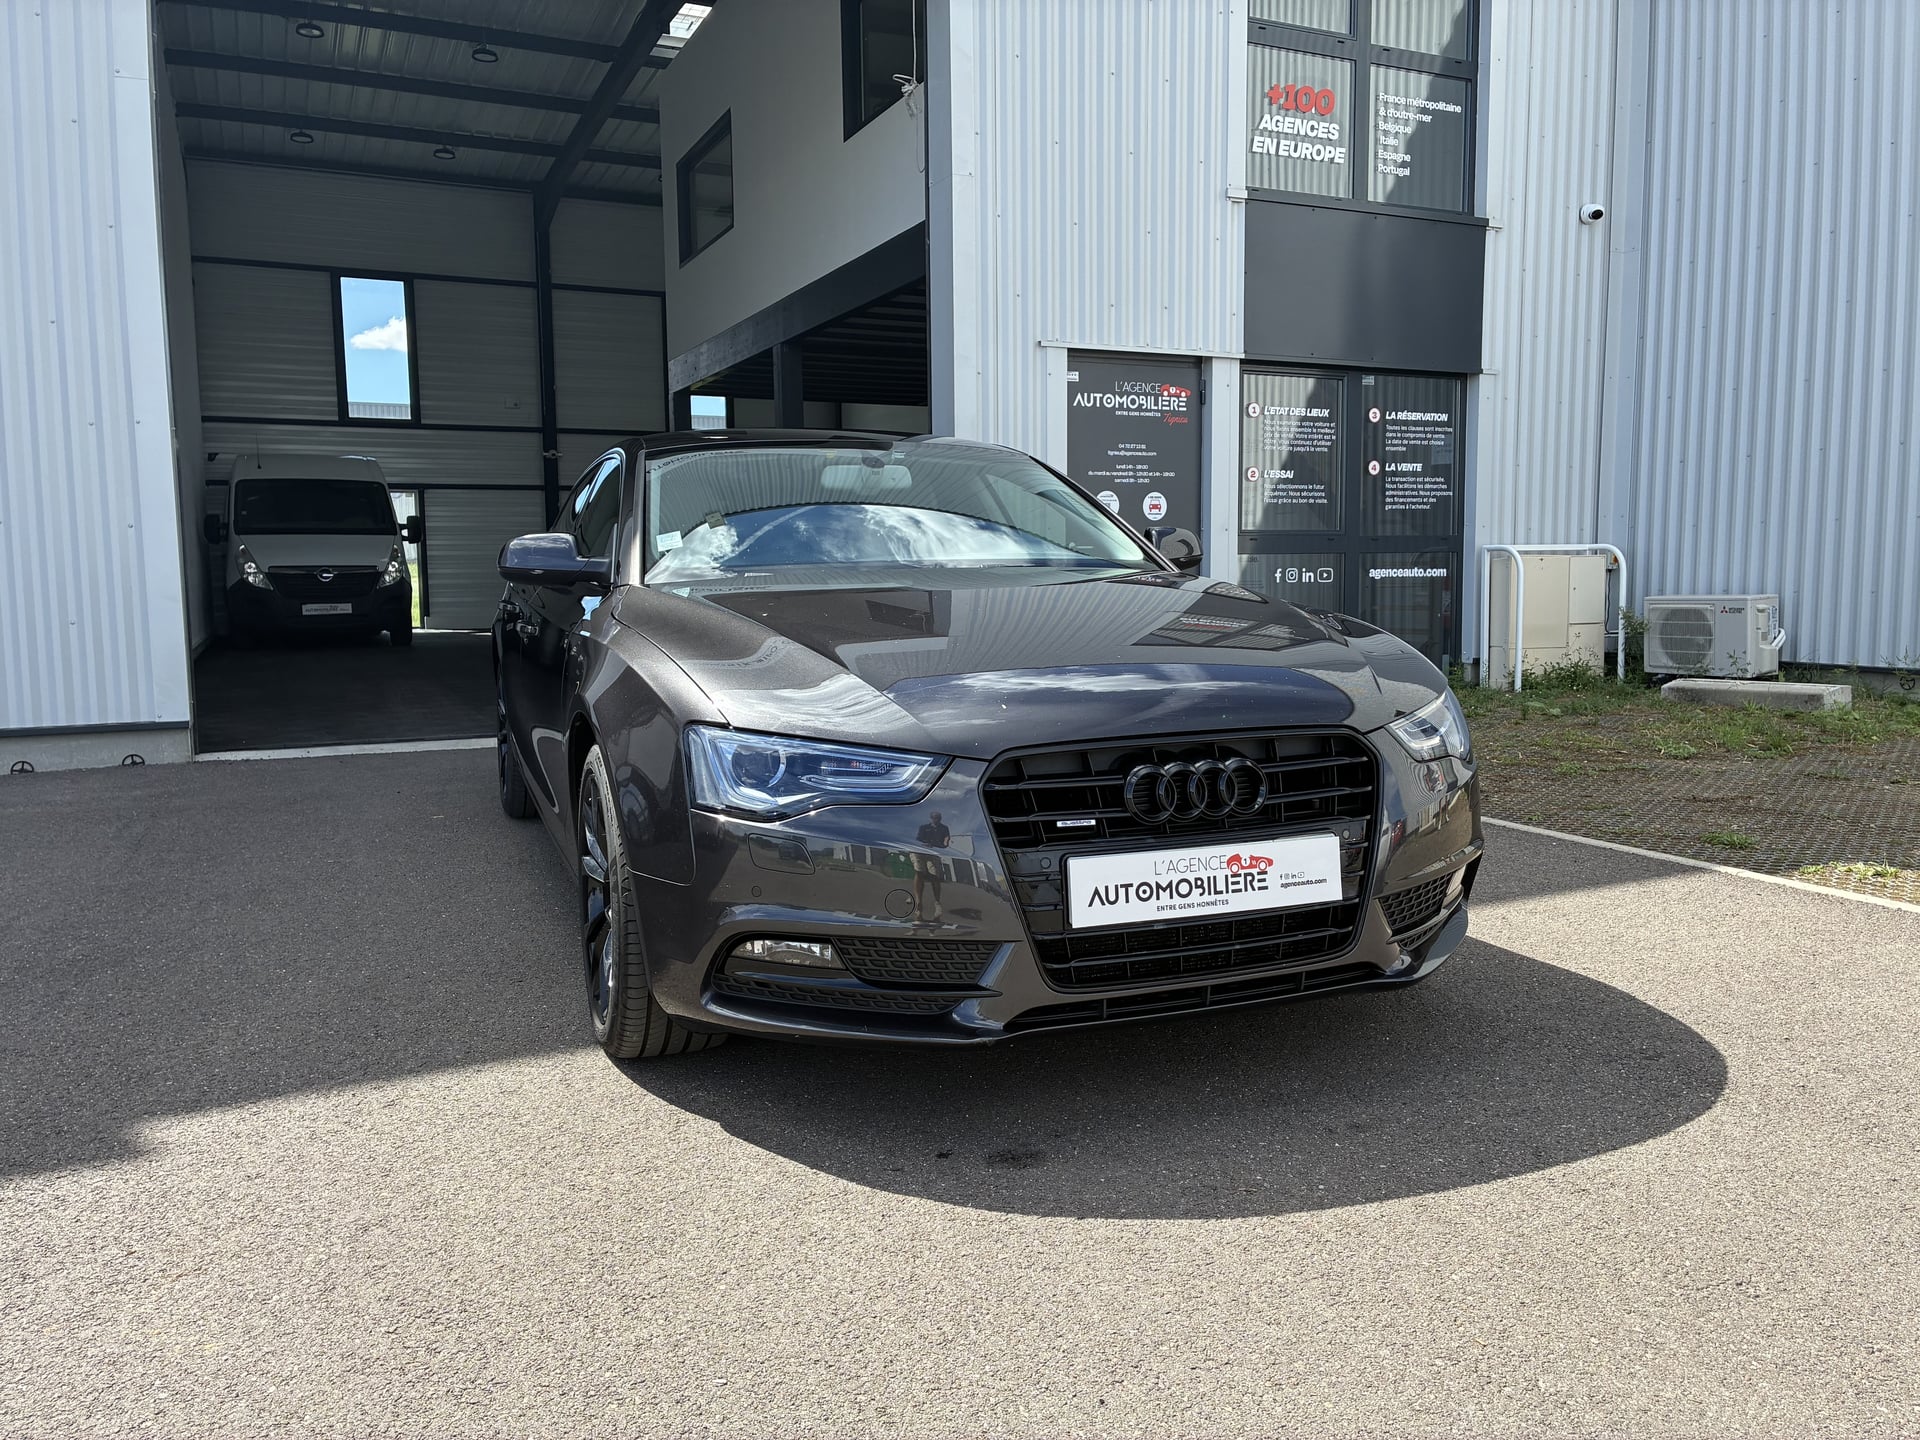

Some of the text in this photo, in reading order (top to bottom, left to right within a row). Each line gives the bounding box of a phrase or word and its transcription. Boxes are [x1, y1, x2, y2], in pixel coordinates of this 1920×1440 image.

[1267, 84, 1336, 116] +100
[1379, 92, 1462, 113] France métropolitaine
[1379, 107, 1432, 124] & d'outre-mer
[1259, 114, 1340, 140] AGENCES
[1378, 122, 1412, 135] Belgique
[1380, 136, 1399, 146] Italie
[1252, 136, 1346, 163] EN EUROPE
[1378, 150, 1411, 163] Espagne
[1378, 164, 1410, 176] Portugal
[1116, 380, 1161, 394] L'AGENCE
[1290, 408, 1306, 416] DES
[1307, 408, 1330, 417] LIEUX
[1386, 410, 1448, 422] LA RÉSERVATION
[1385, 463, 1422, 472] LA VENTE
[1264, 470, 1294, 479] L'ESSAI
[1302, 568, 1314, 582] in
[1369, 568, 1446, 579] agenceauto.com
[1154, 855, 1227, 876] L'AGENCE
[1280, 879, 1327, 889] agenceauto.com
[1197, 899, 1229, 908] HONNÊTES
